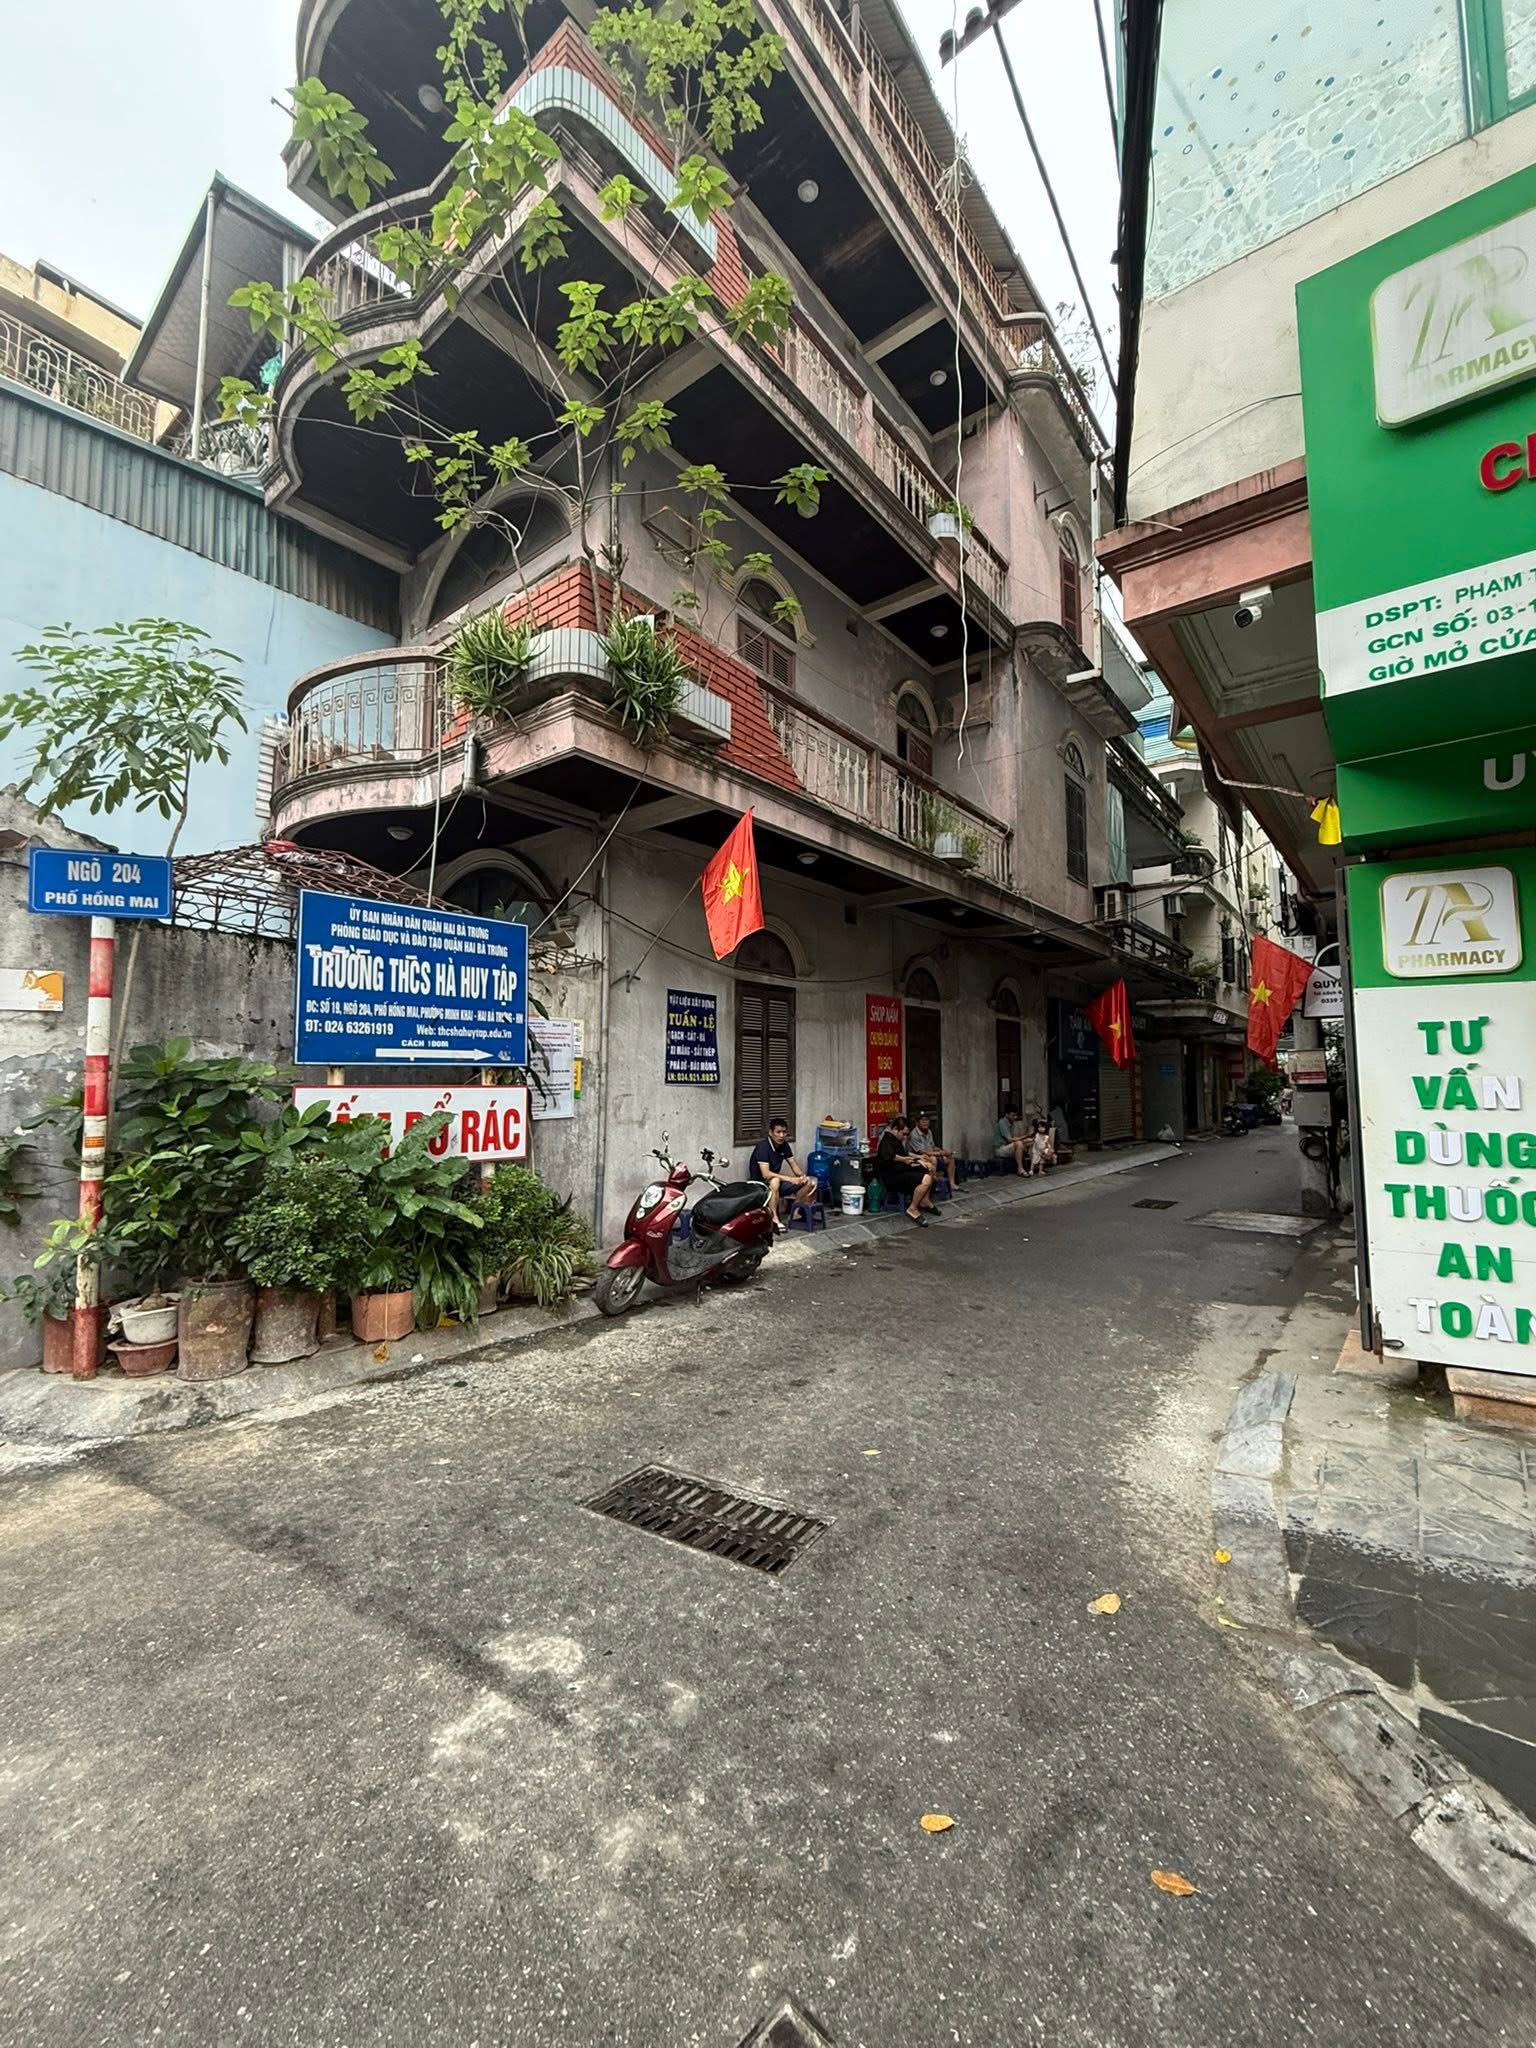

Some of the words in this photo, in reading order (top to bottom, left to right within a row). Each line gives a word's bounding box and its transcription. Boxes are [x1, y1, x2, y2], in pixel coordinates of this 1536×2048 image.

[1480, 432, 1536, 491] C
[1365, 596, 1442, 628] DSPT:
[1455, 572, 1522, 604] PHẠM
[1367, 628, 1423, 653] GCN
[1432, 607, 1478, 637] SỐ:
[1368, 656, 1414, 681] GIỜ
[1424, 641, 1469, 669] MỞ
[1479, 627, 1536, 654] CỬA
[1483, 750, 1536, 790] U
[67, 858, 101, 882] NGÕ
[112, 862, 141, 884] 204
[44, 889, 78, 905] PHỐ
[82, 888, 125, 907] HỒNG
[129, 897, 159, 909] MAI
[331, 923, 360, 939] PHÒNG
[362, 925, 382, 941] GIÁO
[383, 930, 399, 946] DỤC
[400, 929, 411, 945] VÀ
[411, 932, 427, 948] ĐÀO
[428, 937, 443, 952] TẠO
[443, 936, 463, 952] QUẬN
[464, 942, 476, 954] HAI
[476, 940, 486, 955] BÀ
[349, 904, 361, 921] ỦY
[362, 911, 379, 923] BAN
[381, 912, 403, 927] NHÂN
[404, 915, 421, 930] DÂN
[421, 917, 442, 934] QUẬN
[443, 923, 456, 935] HAI
[457, 921, 467, 936] BÀ
[307, 944, 384, 992] TRƯỜNG
[389, 954, 431, 995] THCS
[435, 958, 456, 997] HÀ
[461, 966, 488, 999] HUY
[491, 960, 518, 1006] TẬP
[1397, 949, 1506, 969] PHARMACY
[304, 1019, 322, 1033] ĐT:
[324, 1020, 344, 1033] 024
[346, 1021, 394, 1035] 63261919
[416, 1024, 436, 1036] Web:
[437, 1026, 512, 1040] thcshahuytap.edu.vn
[319, 997, 330, 1014] SỐ
[373, 1001, 388, 1016] PHỐ
[477, 1010, 487, 1022] HAI
[669, 1009, 697, 1027] TUẤN
[703, 1013, 715, 1032] LỆ
[401, 1038, 425, 1047] CÁCH
[1417, 1015, 1490, 1055] TƯ
[1411, 1062, 1521, 1110] VẤN
[461, 1100, 521, 1153] RÁC
[1394, 1121, 1536, 1169] DÙNG
[1437, 1242, 1514, 1283] AN
